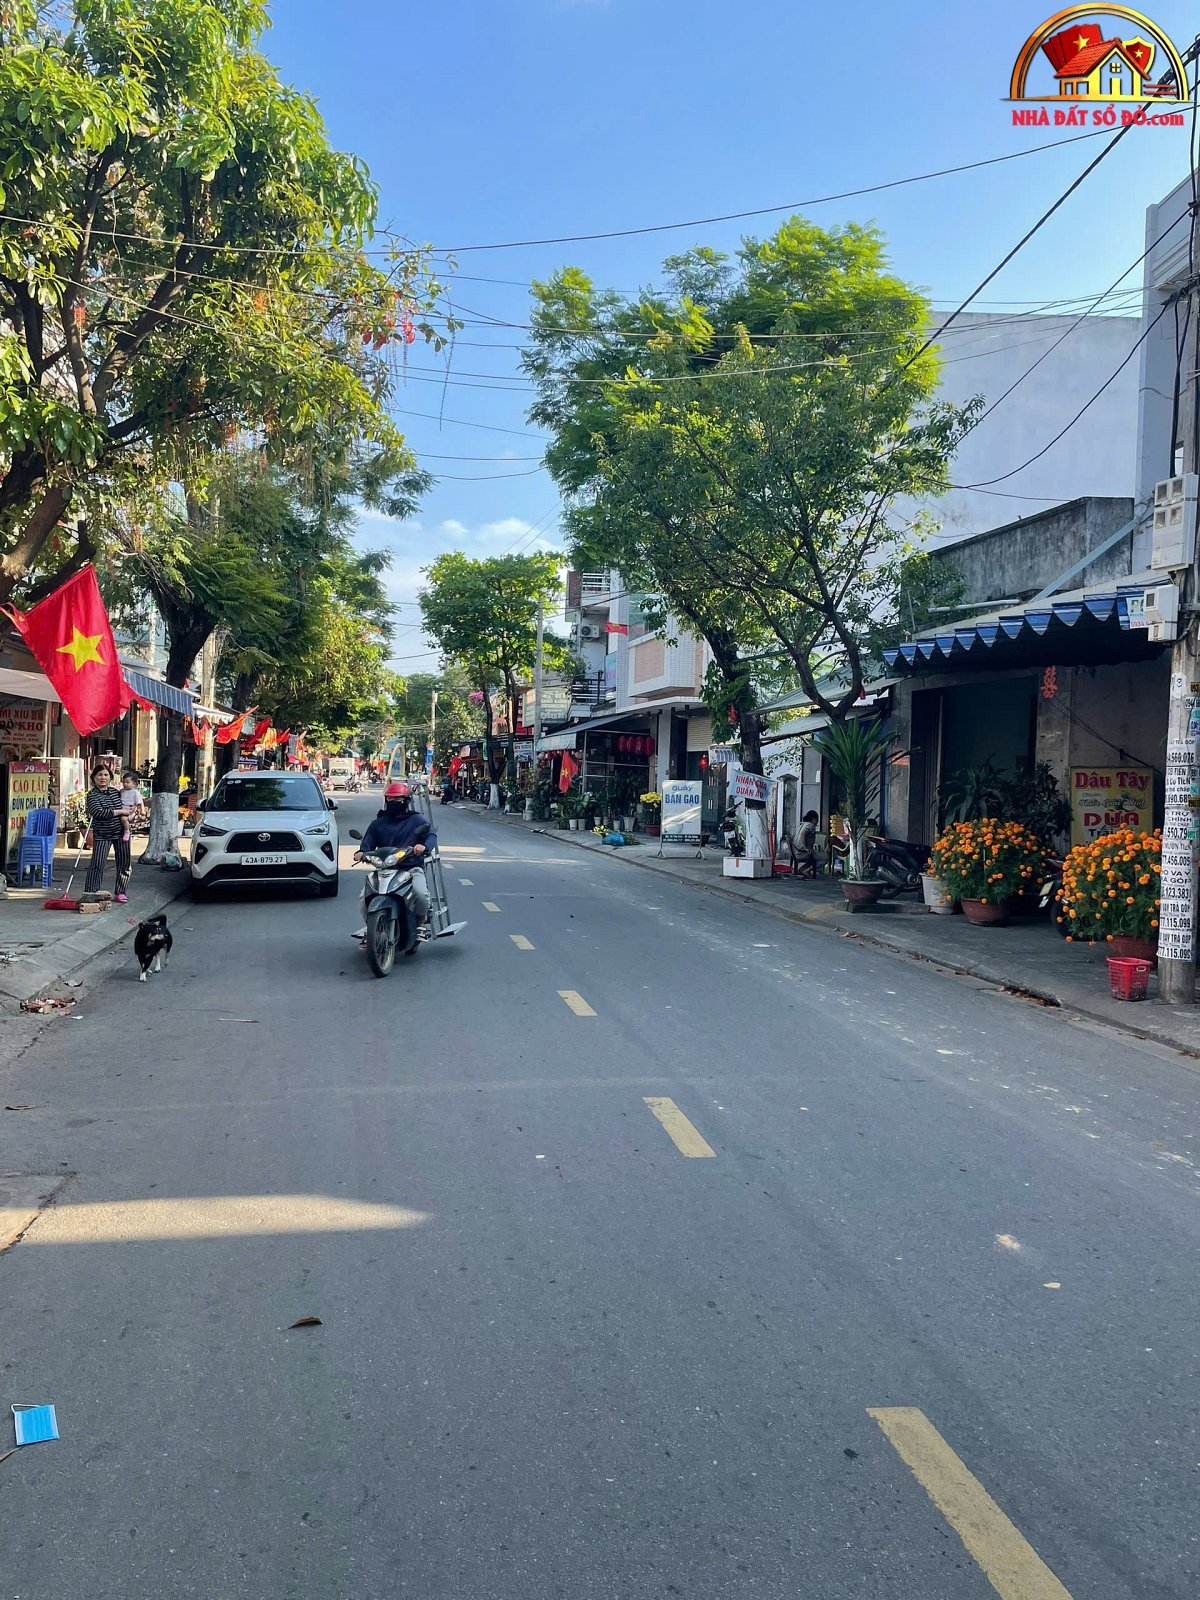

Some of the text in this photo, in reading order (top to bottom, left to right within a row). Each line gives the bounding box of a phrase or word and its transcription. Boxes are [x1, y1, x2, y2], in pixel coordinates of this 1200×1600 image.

[18, 721, 44, 732] KHO
[24, 764, 36, 773] 29
[13, 779, 30, 793] CAO
[1074, 771, 1152, 792] Dâu Tây
[12, 795, 26, 810] BÚN
[683, 793, 700, 807] GẠO
[10, 814, 28, 831] BÚN
